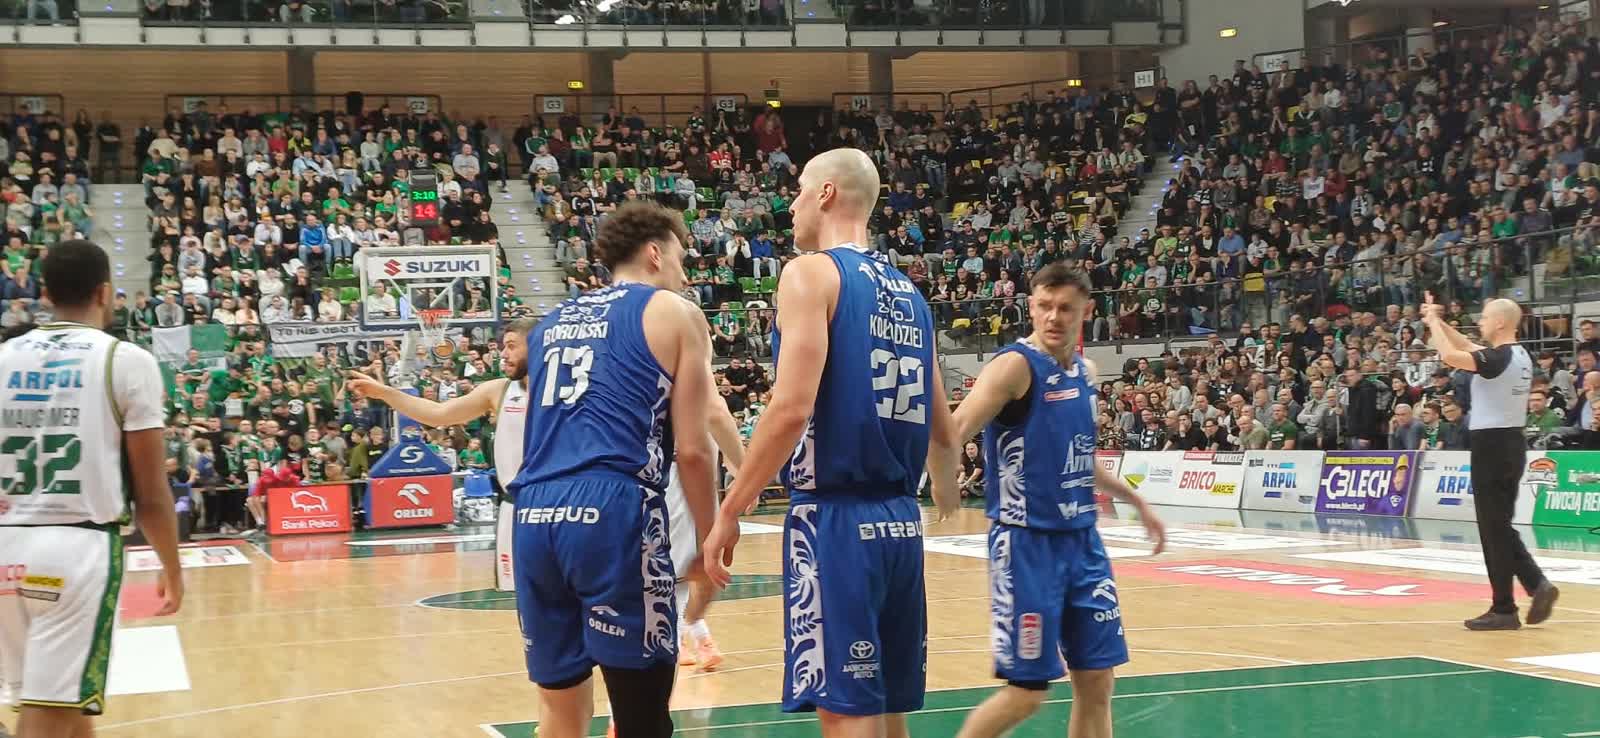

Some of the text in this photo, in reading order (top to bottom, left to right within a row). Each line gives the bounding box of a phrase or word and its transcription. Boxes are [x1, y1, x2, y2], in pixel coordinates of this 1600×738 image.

[412, 191, 435, 201] 3:10
[415, 204, 437, 218] 14
[406, 259, 480, 274] SUZUKI
[7, 368, 84, 390] ARPOL
[541, 345, 594, 407] 13
[870, 348, 926, 425] 22
[0, 433, 82, 495] 32
[1179, 471, 1217, 490] BRICO
[1262, 471, 1297, 489] ARPOL
[393, 508, 434, 519] ORLEN
[518, 506, 600, 525] TERBUD
[281, 519, 339, 530] Bank Pekao
[588, 617, 626, 637] ORLEN
